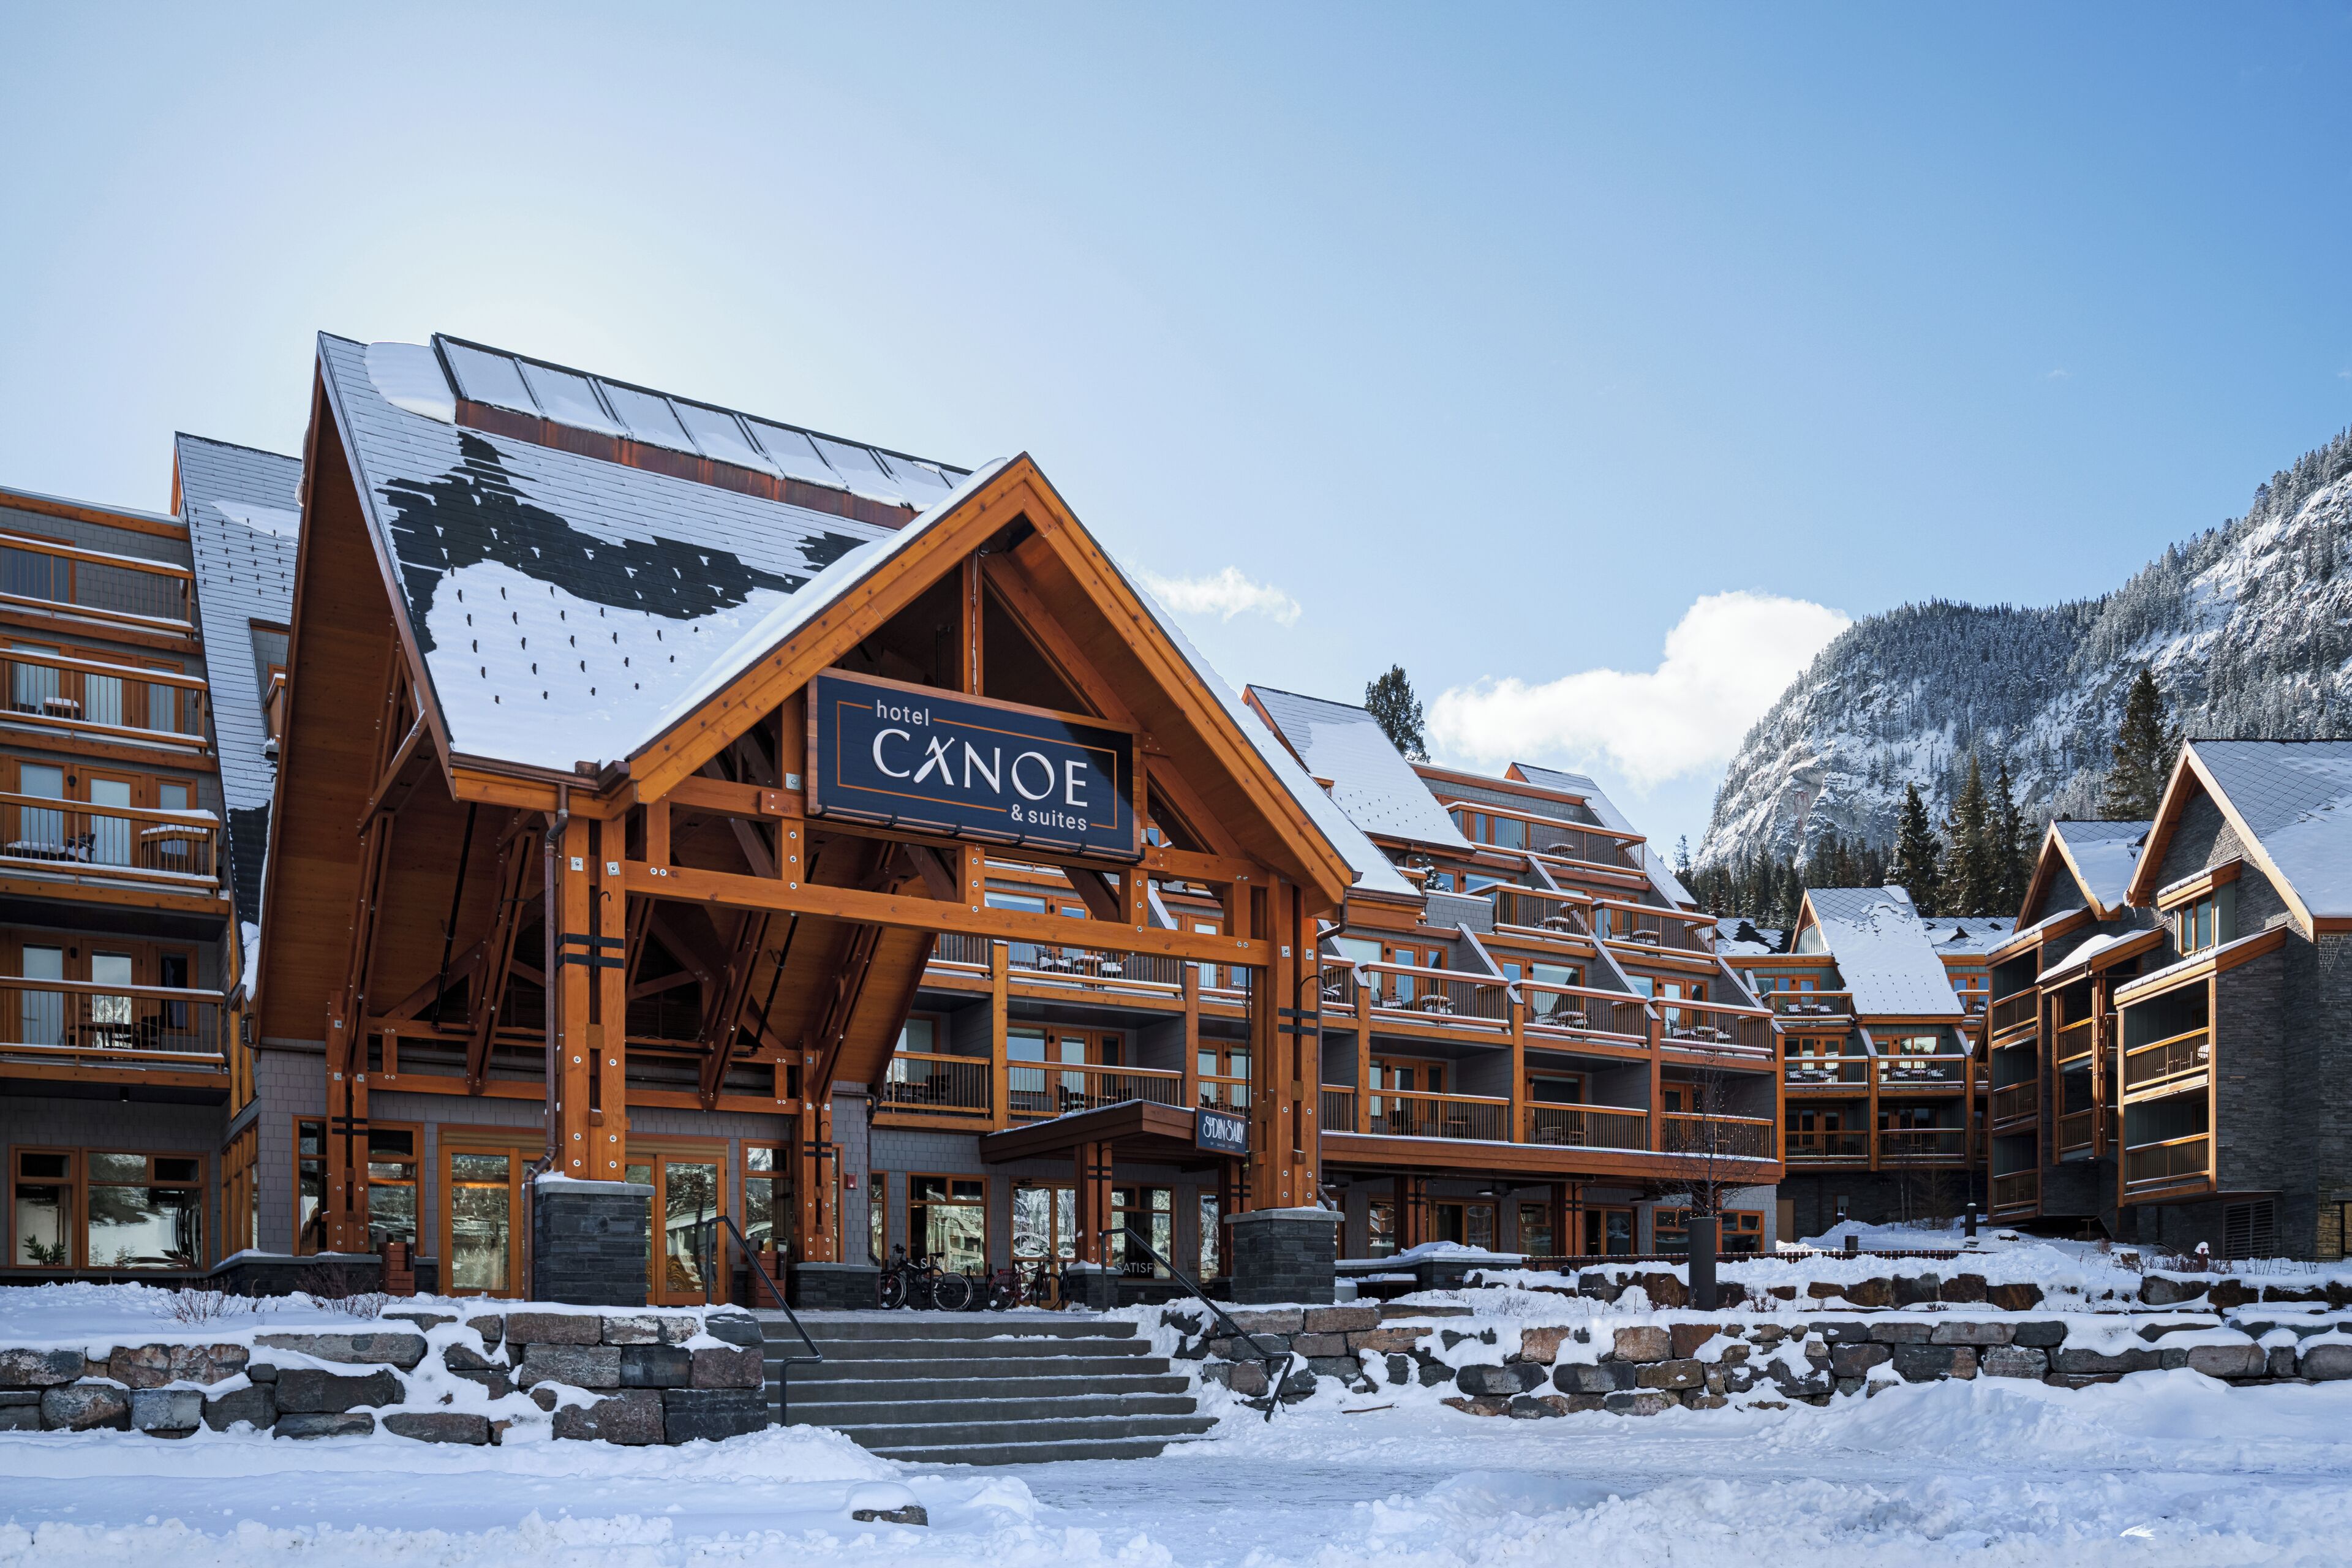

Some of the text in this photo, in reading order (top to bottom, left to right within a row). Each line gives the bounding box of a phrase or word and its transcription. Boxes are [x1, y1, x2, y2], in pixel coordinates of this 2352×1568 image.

[876, 699, 929, 726] hotel
[872, 728, 1088, 807] CANOE
[1011, 804, 1087, 831] & suites
[1116, 1262, 1160, 1273] SATISFY
